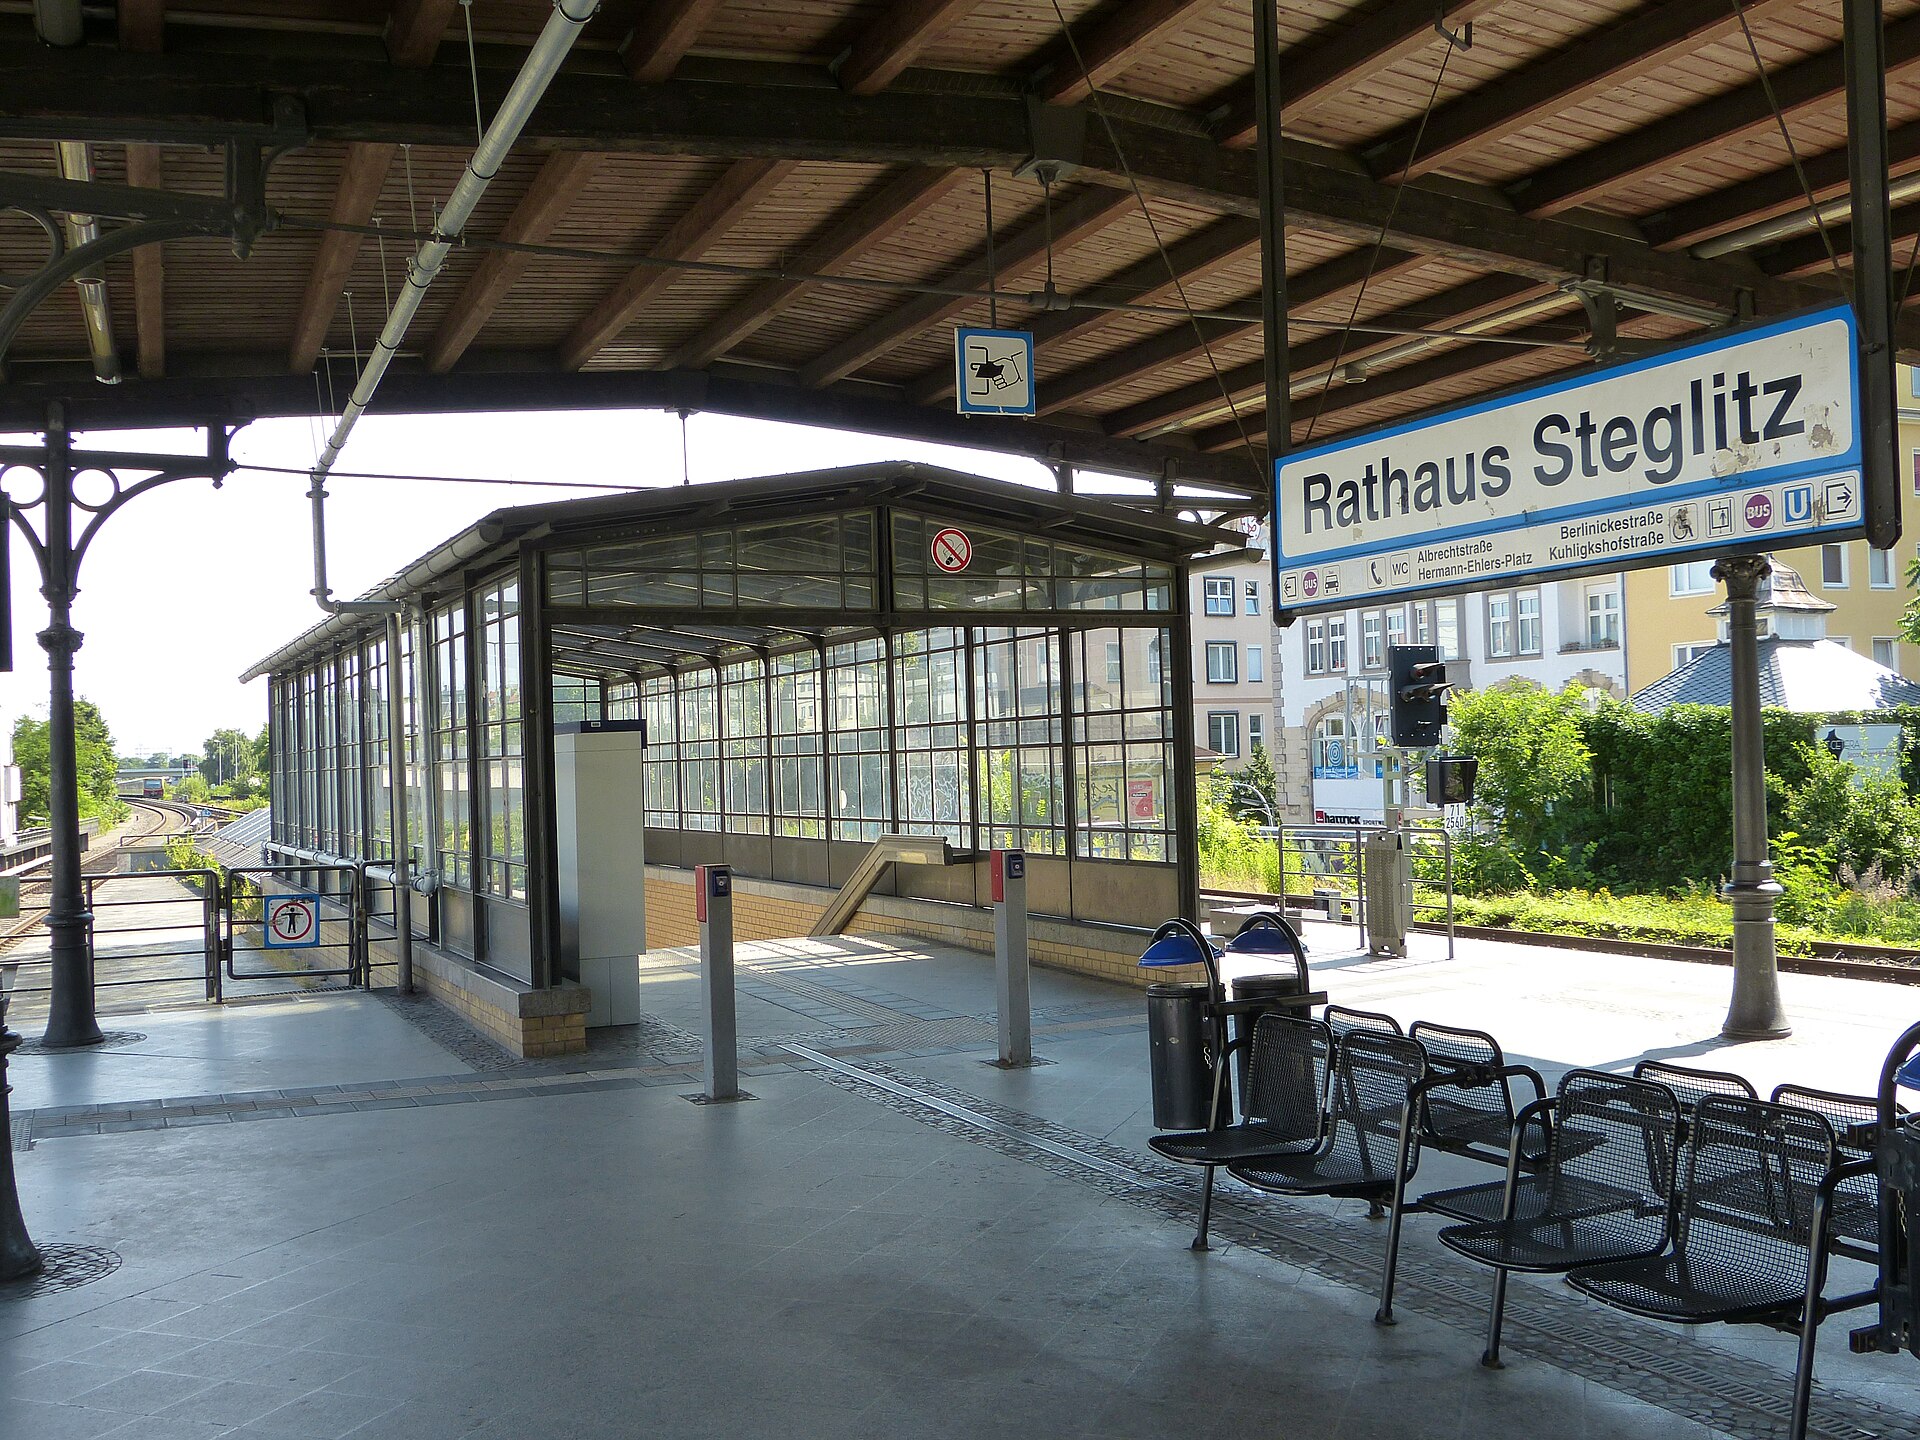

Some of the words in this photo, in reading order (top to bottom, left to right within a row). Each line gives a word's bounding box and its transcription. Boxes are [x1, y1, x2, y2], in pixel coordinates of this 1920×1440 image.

[1304, 444, 1512, 535] Rathaus
[1532, 371, 1806, 484] Steglitz
[1746, 504, 1771, 520] BUS
[1788, 490, 1807, 520] U
[1560, 511, 1664, 540] Berlinickestraße
[1417, 540, 1493, 563] Albrechtstraße
[1549, 532, 1665, 561] Kuhligkshofstraße
[1391, 562, 1409, 576] WC
[1417, 552, 1533, 581] Hermann-Ehlers-Platz
[1304, 578, 1318, 590] BUS
[1450, 803, 1460, 816] 71
